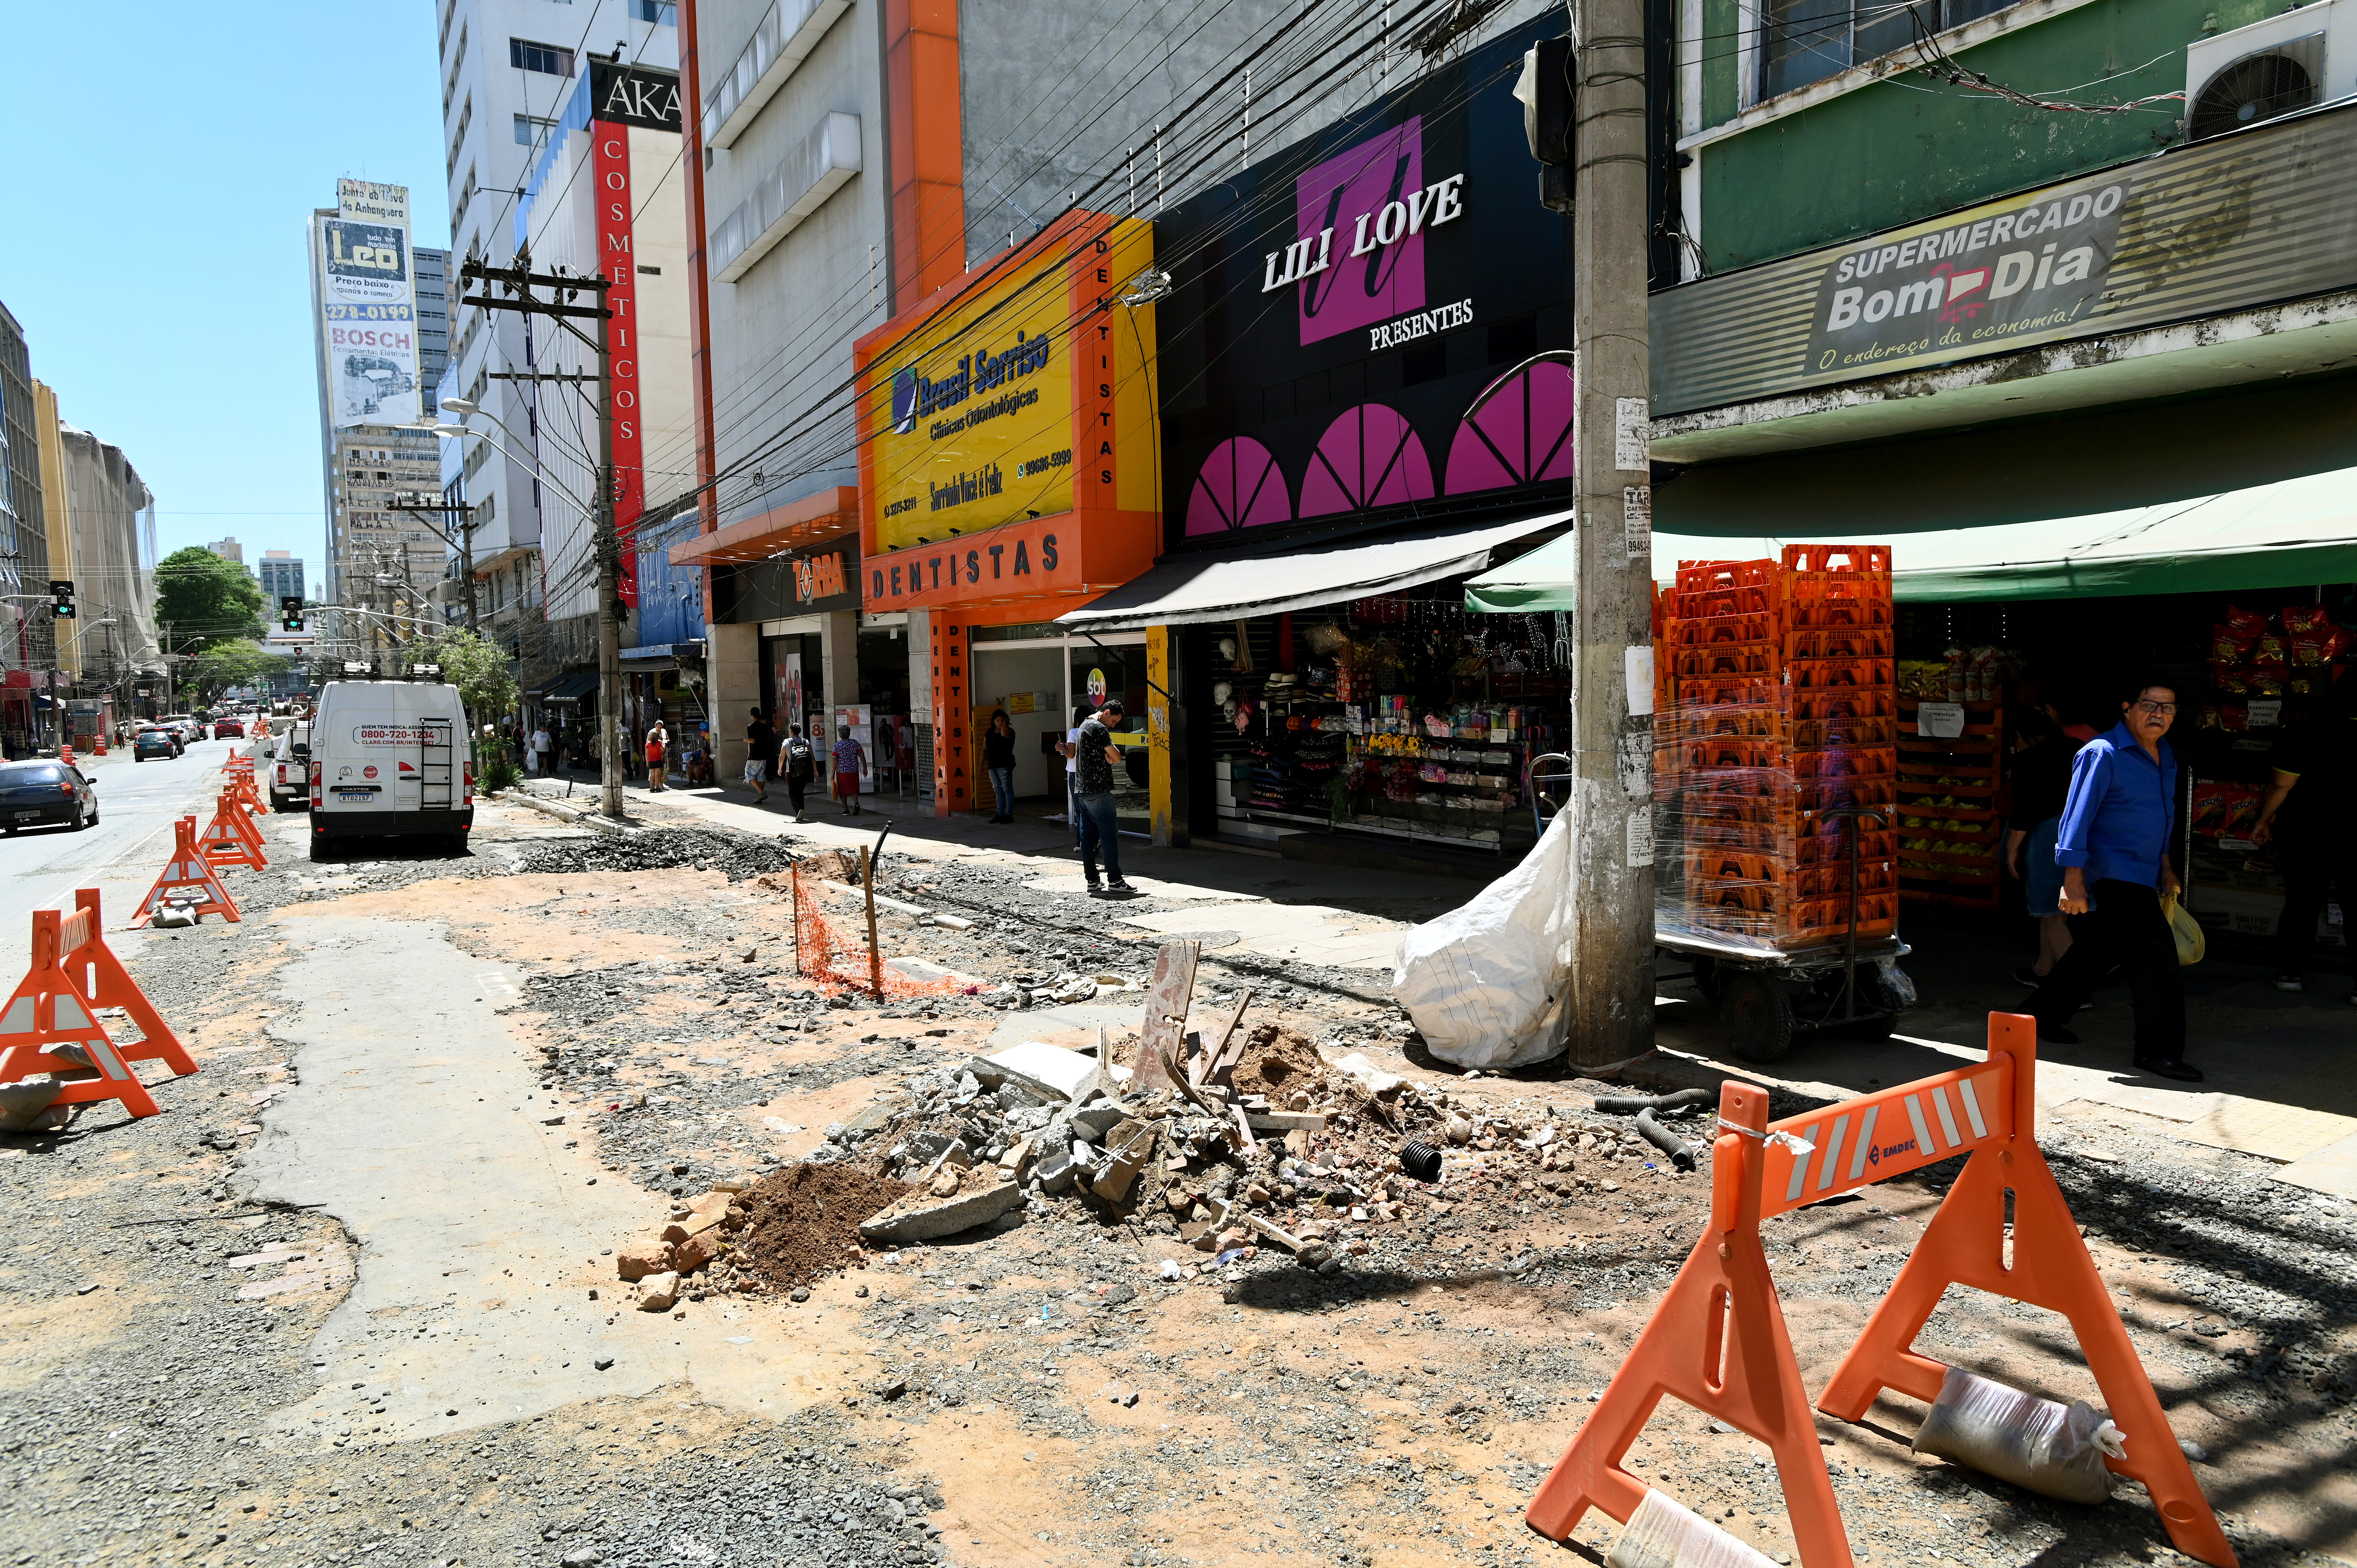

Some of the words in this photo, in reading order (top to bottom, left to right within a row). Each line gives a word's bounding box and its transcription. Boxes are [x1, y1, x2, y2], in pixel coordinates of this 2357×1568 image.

[603, 76, 682, 123] AKA
[342, 185, 364, 198] Junto
[369, 191, 378, 200] ao
[343, 200, 352, 211] da
[355, 202, 403, 218] Anhanguera
[1262, 227, 1333, 293] LILI
[1350, 173, 1464, 257] LOVE
[1836, 185, 2122, 283] SUPERMERCADO
[336, 276, 362, 288] Preço
[364, 279, 389, 288] baixo
[604, 141, 634, 438] COSMÉTICOS
[1827, 277, 1946, 332] Bom
[1988, 242, 2094, 300] Dia
[327, 306, 408, 319] 278-0199
[1370, 298, 1473, 351] PRESENTES
[1819, 350, 1836, 369] O
[1844, 338, 1928, 364] endereço
[1939, 326, 1961, 345] da
[1972, 297, 2083, 340] economia!
[332, 328, 410, 349] BOSCH
[333, 346, 378, 355] Ferramentas
[380, 349, 409, 357] Elétricas
[1095, 240, 1112, 484] DENTISTAS
[919, 353, 970, 418] Brasil
[974, 331, 1049, 394] Sorriso
[929, 416, 965, 441] Clínicas
[966, 387, 1039, 428] Odontológicas
[930, 475, 960, 512] Sorrindo
[959, 472, 977, 503] Você
[979, 470, 984, 498] é
[985, 462, 1002, 497] Feliz
[1025, 449, 1072, 477] 99686-5999
[793, 551, 848, 605] TORRA
[873, 534, 1058, 598] DENTISTAS
[1088, 674, 1106, 696] sbt
[933, 625, 943, 798] DENTISTAS
[949, 625, 964, 798] DENTISTAS
[2196, 795, 2224, 809] NESCAU
[2229, 798, 2258, 812] NESCAU
[2242, 925, 2268, 933] VONTADE!
[1883, 1138, 1915, 1159] EMDEC
